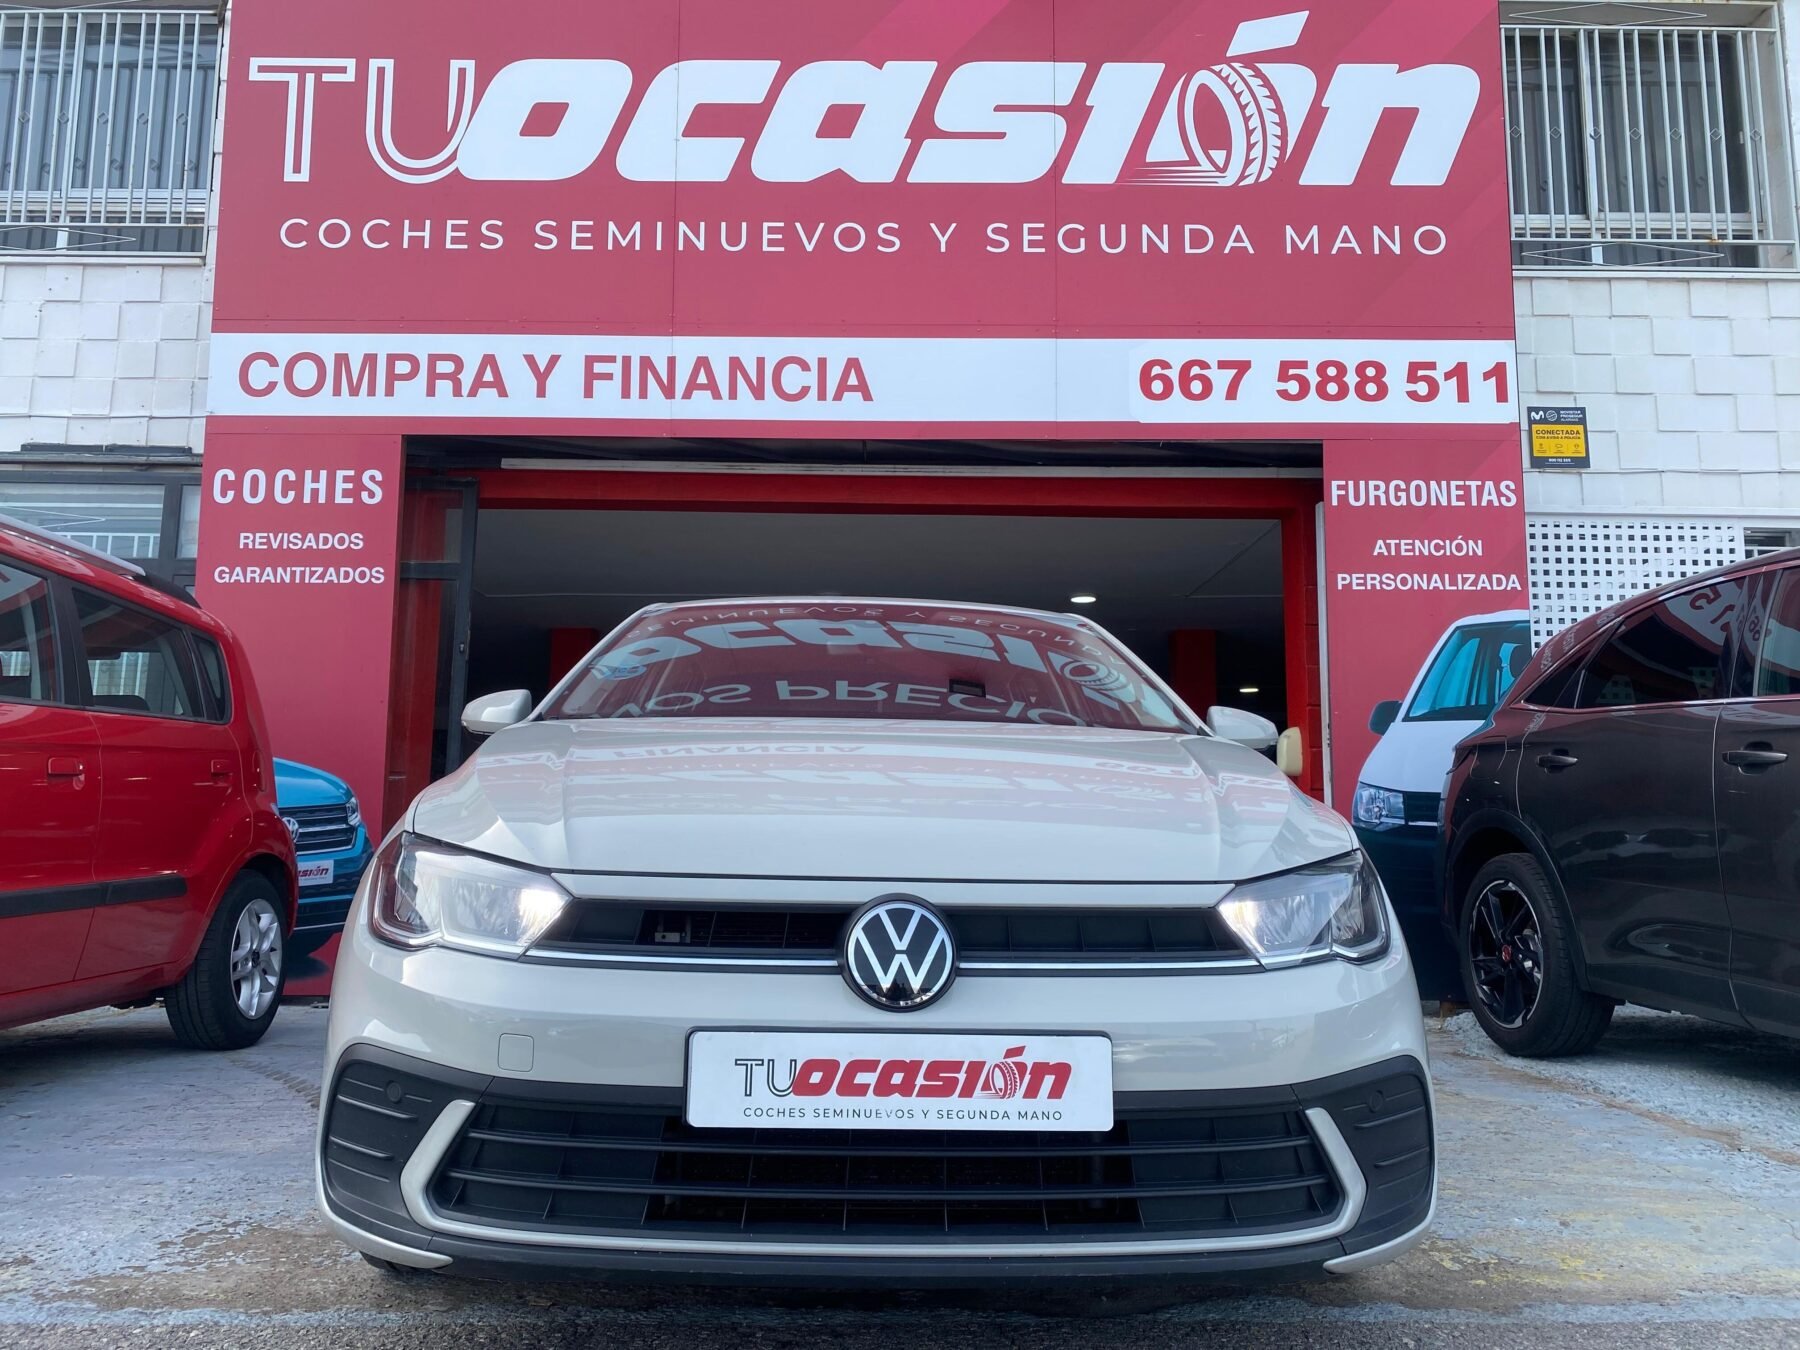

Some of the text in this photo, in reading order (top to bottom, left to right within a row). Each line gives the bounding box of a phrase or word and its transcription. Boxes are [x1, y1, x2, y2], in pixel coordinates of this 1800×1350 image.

[279, 217, 1447, 256] COCHES SEMINUEVOS Y SEGUNDA MANO
[237, 351, 874, 402] COMPRA Y FINANCIA
[1138, 358, 1510, 404] 667 588 511
[212, 468, 384, 505] COCHES
[1330, 479, 1518, 507] FURGONETAS
[239, 532, 365, 550] REVISADOS
[1373, 535, 1483, 557] ATENCIÓN
[213, 566, 385, 584] GARANTIZADOS
[1336, 573, 1522, 591] PERSONALIZADA
[743, 1107, 1063, 1121] COCHES SEMINUEVOS Y SEGUNDA MANO
